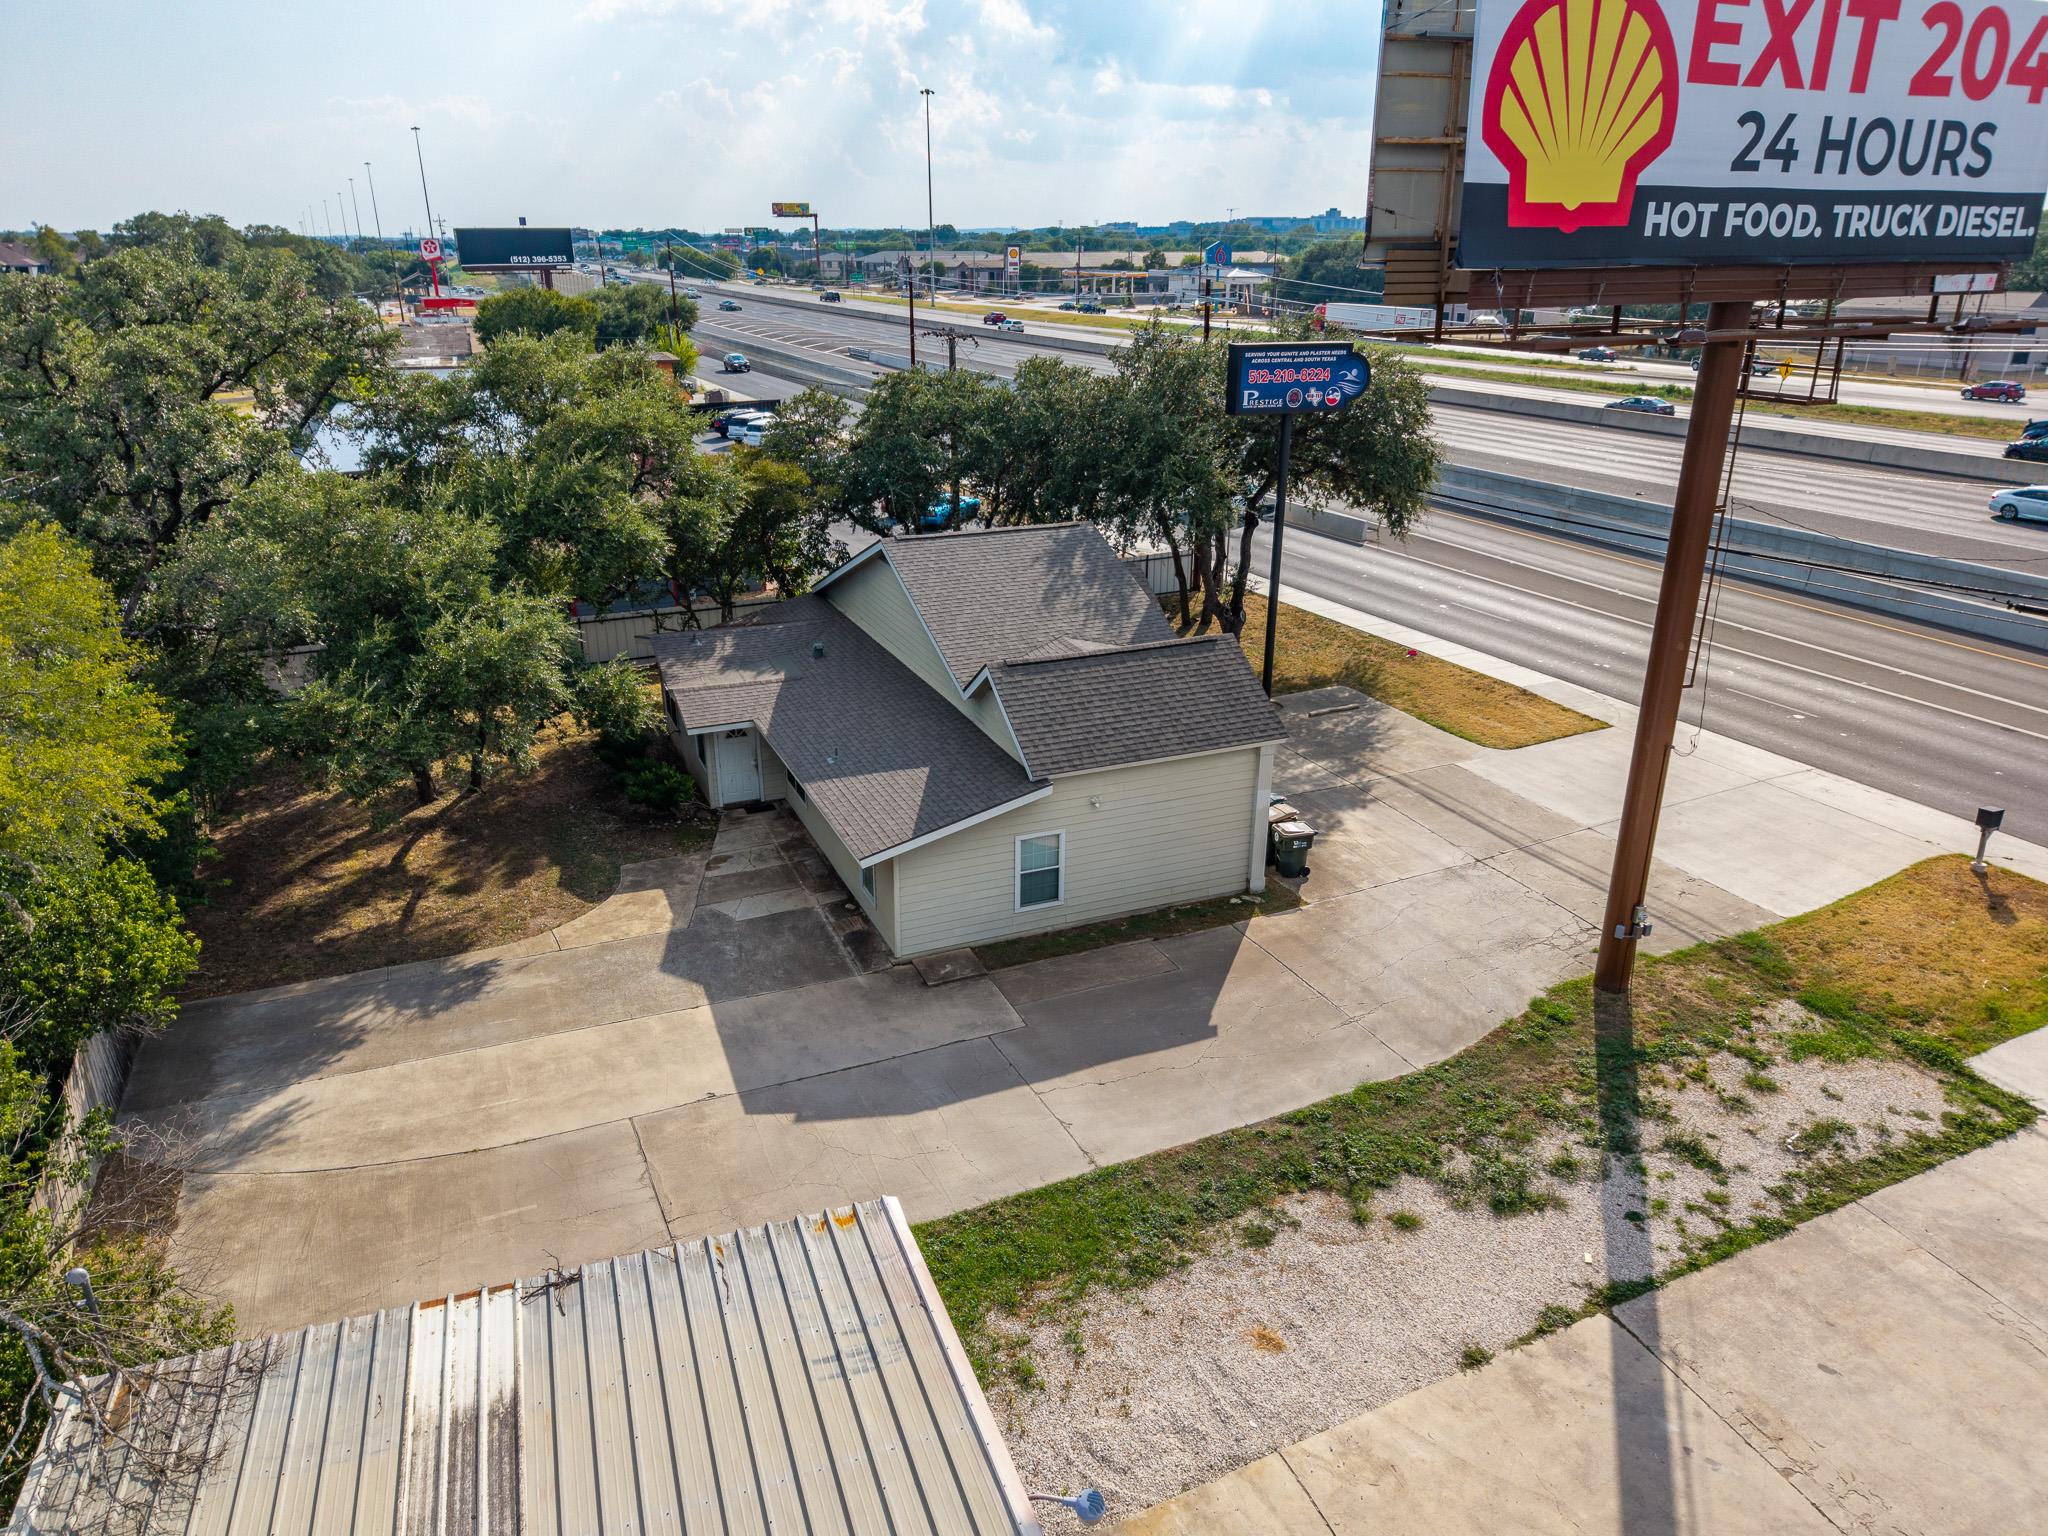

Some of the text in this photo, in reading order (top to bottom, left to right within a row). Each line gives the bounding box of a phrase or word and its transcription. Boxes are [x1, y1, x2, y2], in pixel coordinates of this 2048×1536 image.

[1686, 0, 2048, 104] EXIT 204
[1730, 110, 1998, 178] 24 HOURS
[1643, 201, 2036, 238] HOT FOOD. TRUCK DIESEL.
[510, 256, 530, 264] (512)
[1248, 368, 1330, 384] 512-210-8224
[1242, 390, 1283, 406] PRESTIGE
